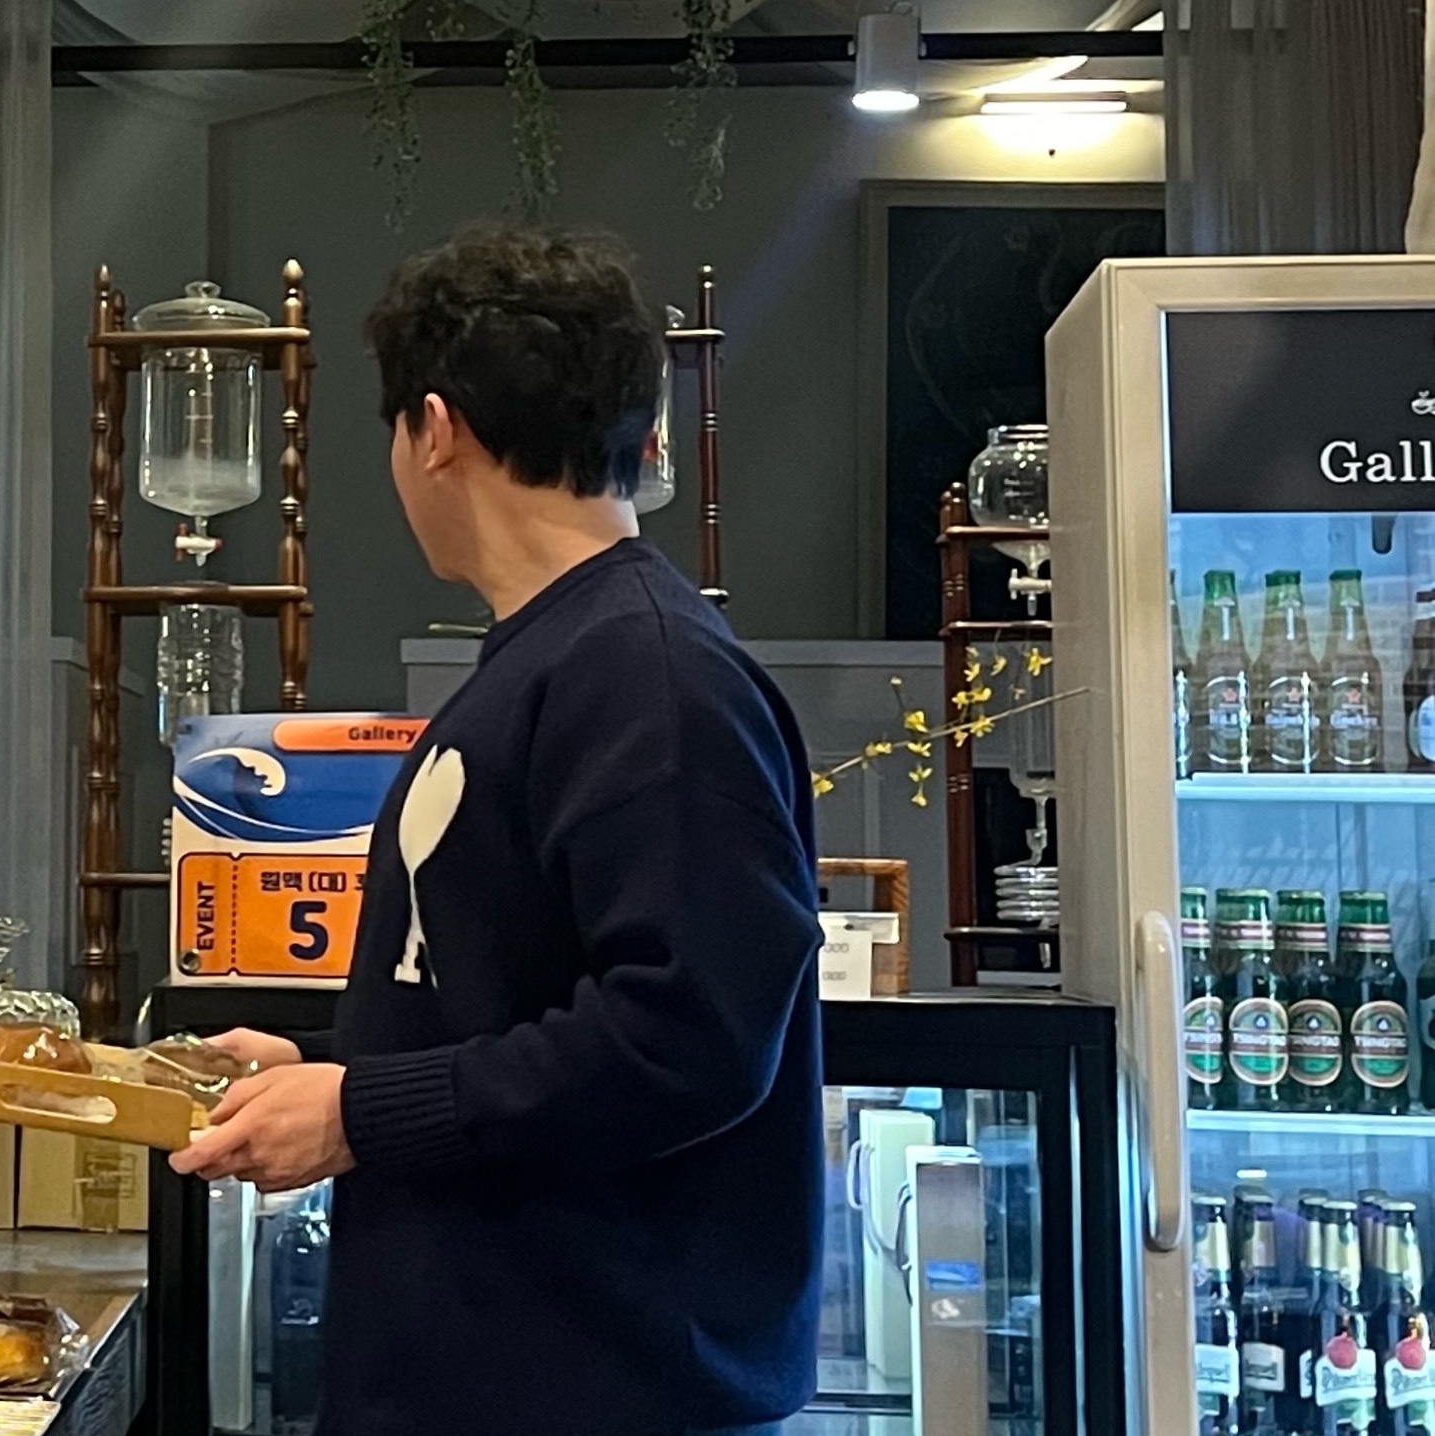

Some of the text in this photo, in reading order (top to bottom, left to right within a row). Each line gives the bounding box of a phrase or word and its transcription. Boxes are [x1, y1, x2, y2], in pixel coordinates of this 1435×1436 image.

[1320, 440, 1435, 483] Gall
[349, 725, 416, 743] Gallery
[196, 881, 215, 951] EVENT
[289, 900, 329, 960] 5
